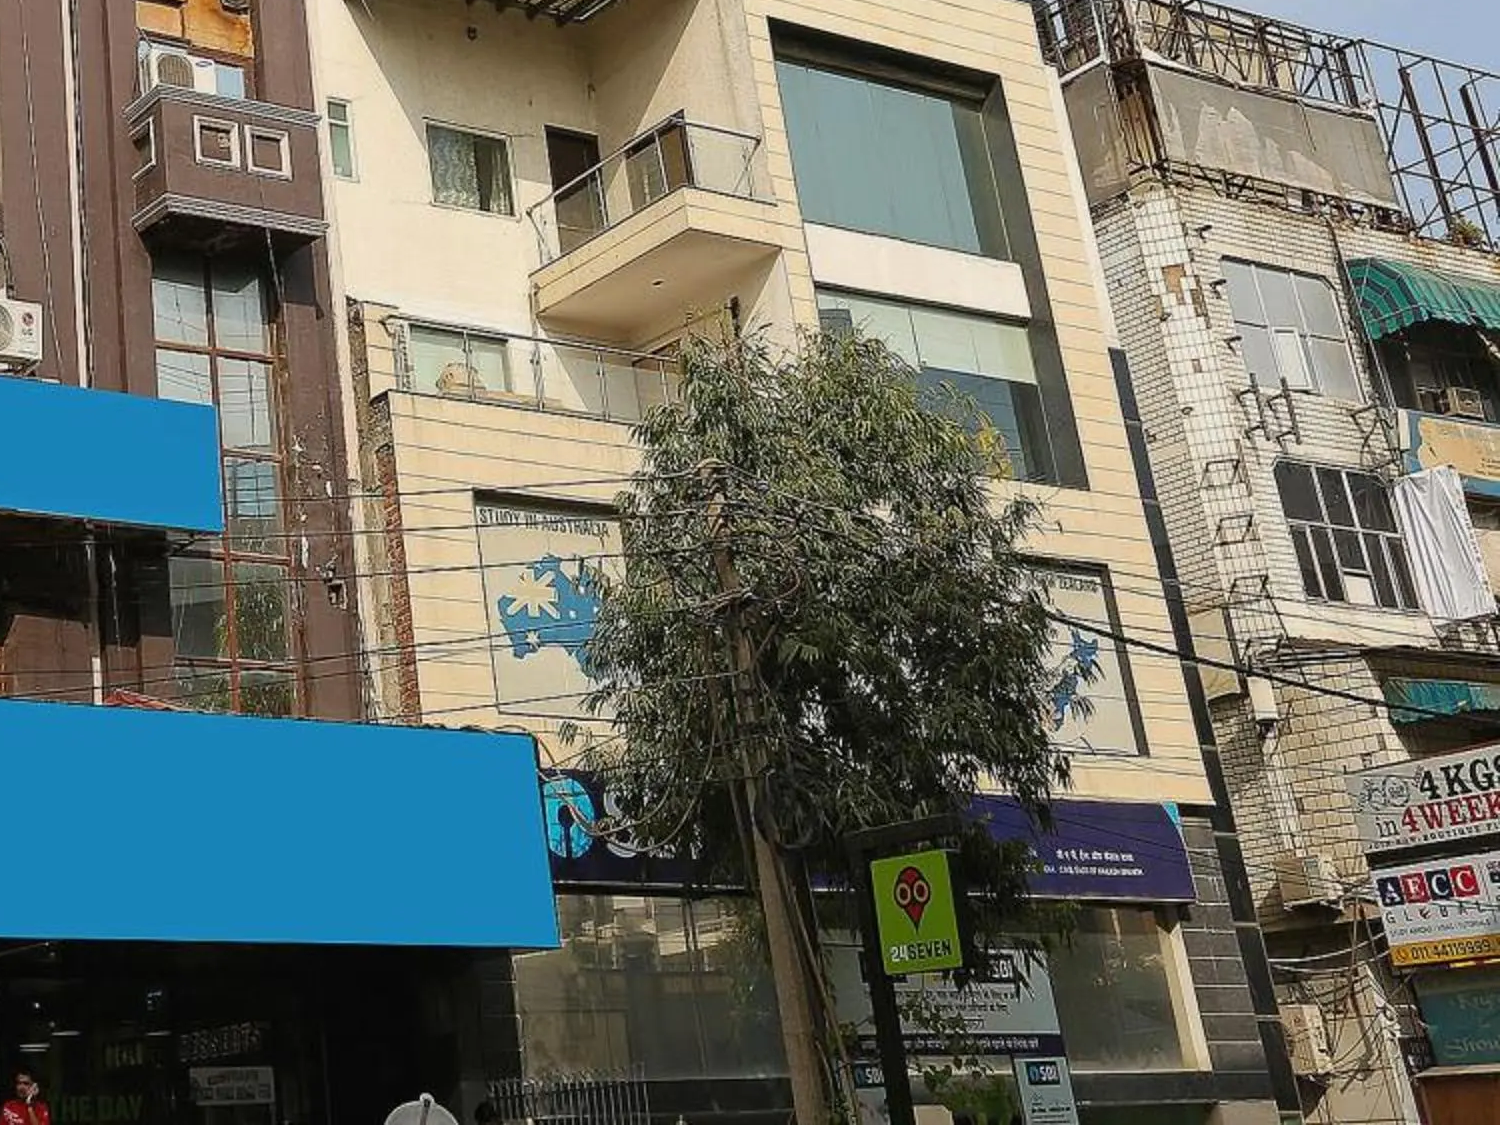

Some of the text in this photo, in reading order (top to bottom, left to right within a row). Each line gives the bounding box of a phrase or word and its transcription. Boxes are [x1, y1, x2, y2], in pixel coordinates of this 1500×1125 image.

[479, 507, 520, 525] STUDY
[541, 515, 610, 538] AUSTRALIA
[1375, 816, 1400, 838] in
[1382, 869, 1476, 904] AECC
[889, 938, 952, 963] 24SEVEN
[1038, 1064, 1059, 1082] SBI
